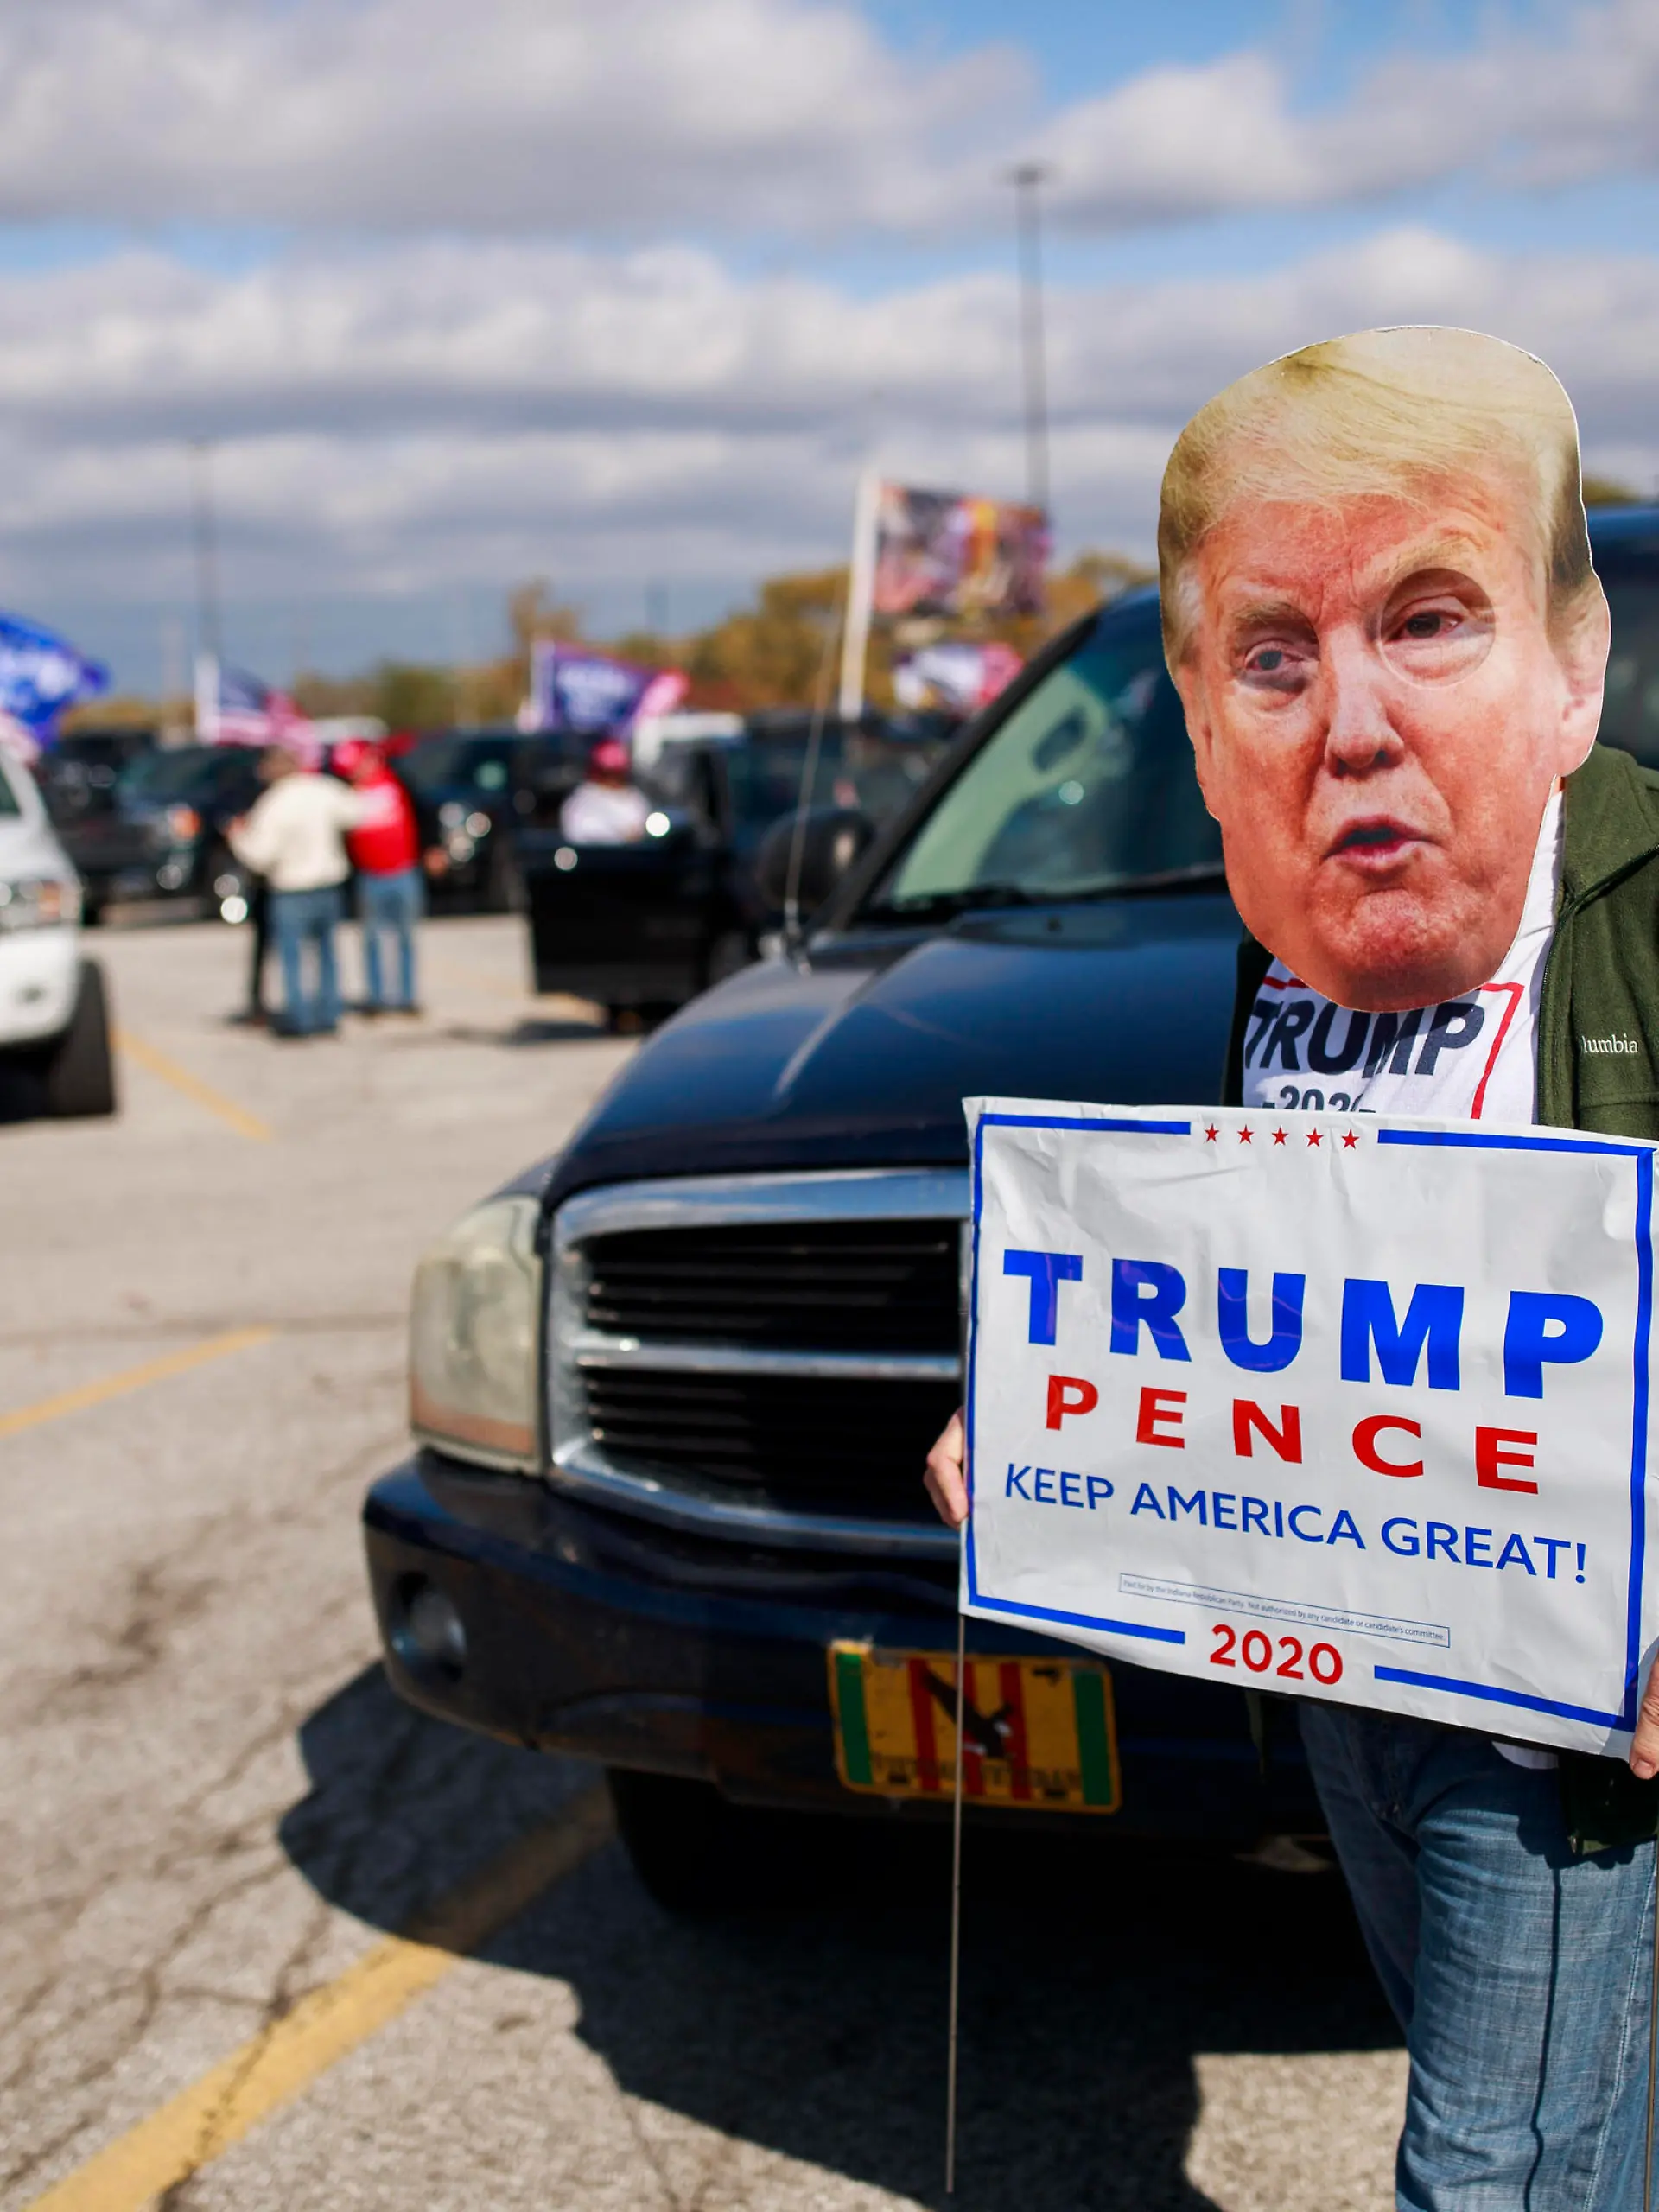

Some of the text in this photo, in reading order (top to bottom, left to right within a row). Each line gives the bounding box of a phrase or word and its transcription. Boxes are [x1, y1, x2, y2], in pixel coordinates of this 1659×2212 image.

[1245, 997, 1485, 1079] TRUMP
[1580, 1033, 1638, 1053] lumbia
[1002, 1249, 1604, 1400] TRUMP
[1046, 1375, 1538, 1495] PENCE
[1005, 1463, 1586, 1584] KEEP AMERICA GREAT!
[1166, 1587, 1192, 1598] Indiana
[1193, 1591, 1225, 1604] Republican
[1248, 1601, 1260, 1610] Not
[1262, 1605, 1296, 1616] authorized
[1298, 1611, 1306, 1619] by
[1307, 1612, 1320, 1621] any
[1321, 1615, 1355, 1625] candidate
[1365, 1621, 1403, 1634] candidate's
[1405, 1629, 1446, 1641] committee.
[1210, 1624, 1344, 1685] 2020
